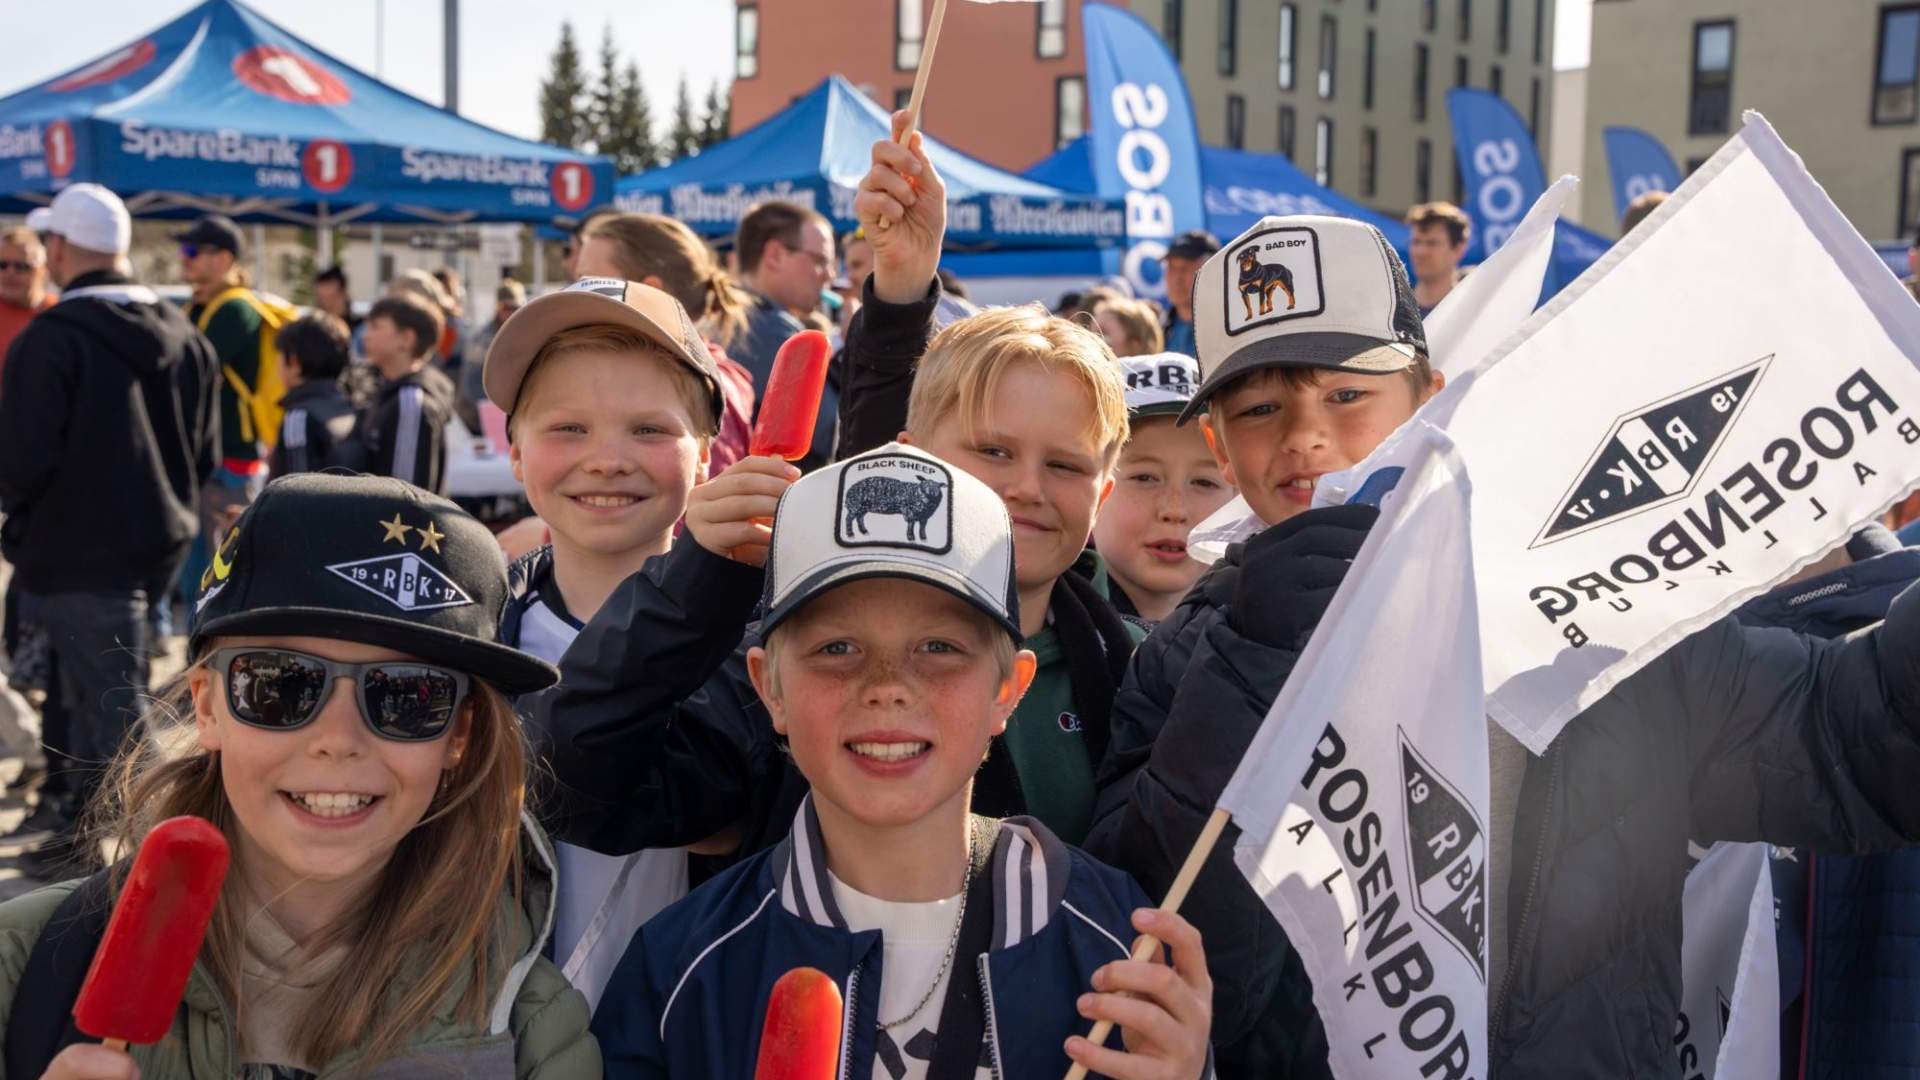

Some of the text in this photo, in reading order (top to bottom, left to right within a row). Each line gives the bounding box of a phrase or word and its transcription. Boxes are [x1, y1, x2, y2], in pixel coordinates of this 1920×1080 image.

[120, 117, 338, 183] SpareBank 1
[402, 147, 548, 188] SpareBank
[561, 165, 582, 202] 1
[1265, 240, 1307, 251] BAD BOY
[857, 460, 936, 474] BLACK SHEEP
[352, 567, 456, 601] 19 RBK 17
[1300, 721, 1480, 1080] ROSENBOR
